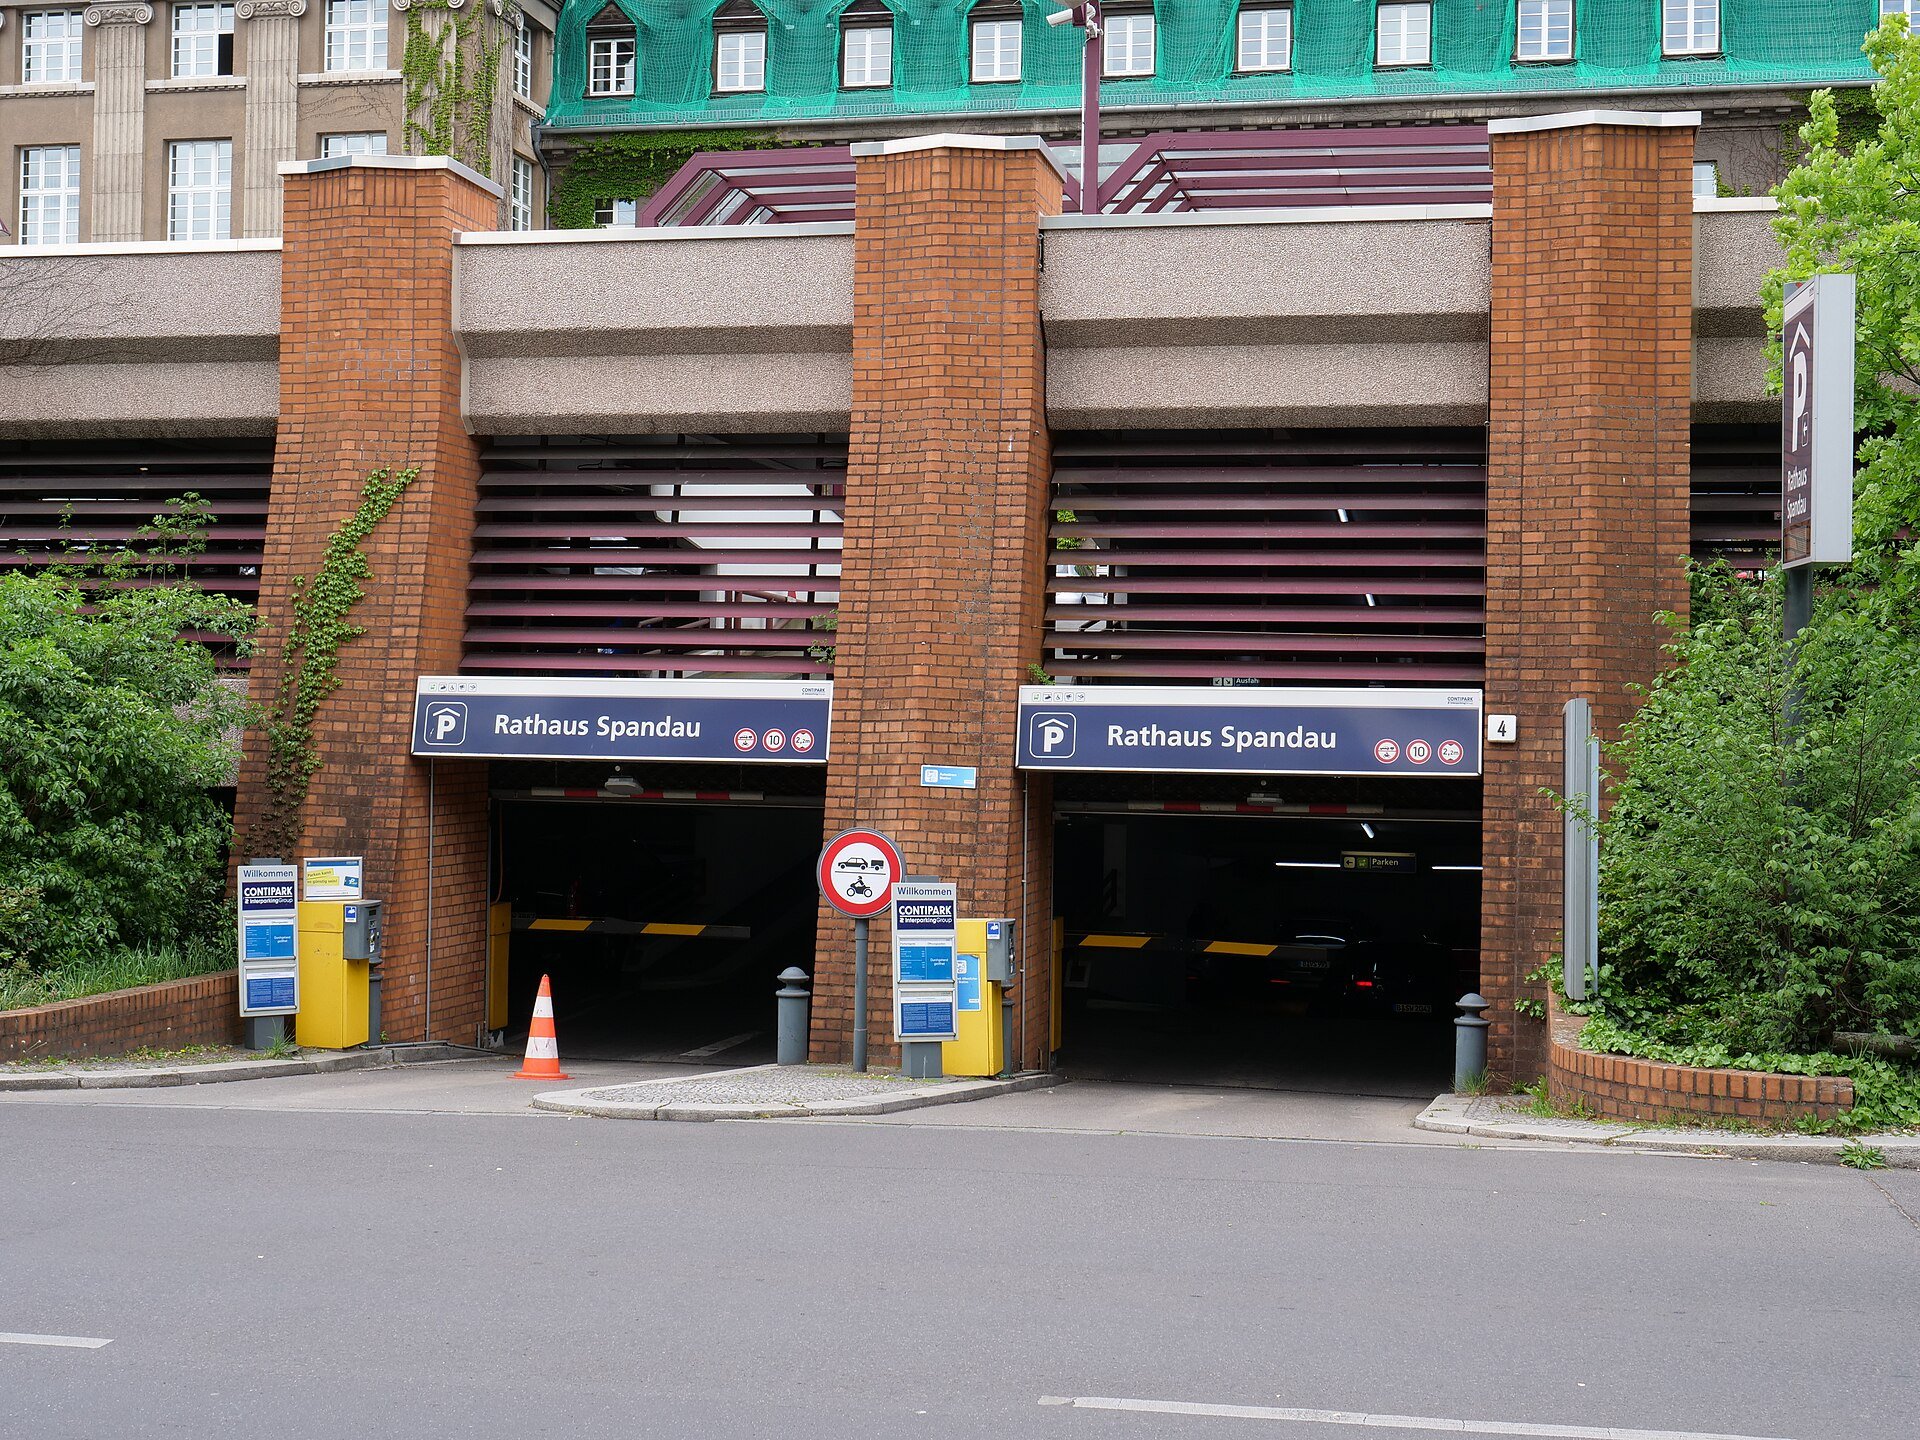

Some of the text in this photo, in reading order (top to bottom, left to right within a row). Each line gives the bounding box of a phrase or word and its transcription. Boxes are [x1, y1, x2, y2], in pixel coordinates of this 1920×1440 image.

[1792, 351, 1807, 452] P
[1788, 465, 1807, 492] Rathaus
[1787, 493, 1807, 524] Spandau
[436, 715, 456, 740] P
[494, 713, 701, 741] Rathaus Spandau
[1497, 720, 1507, 737] 4
[769, 735, 780, 746] 10
[1043, 726, 1064, 753] P
[1107, 723, 1336, 753] Rathaus Spandau
[1413, 746, 1425, 757] 10
[1372, 858, 1399, 866] Parken
[243, 869, 294, 878] Willkommen
[244, 886, 293, 897] CONTIPARK
[897, 886, 952, 896] Willkommen
[898, 905, 952, 915] CONTIPARK
